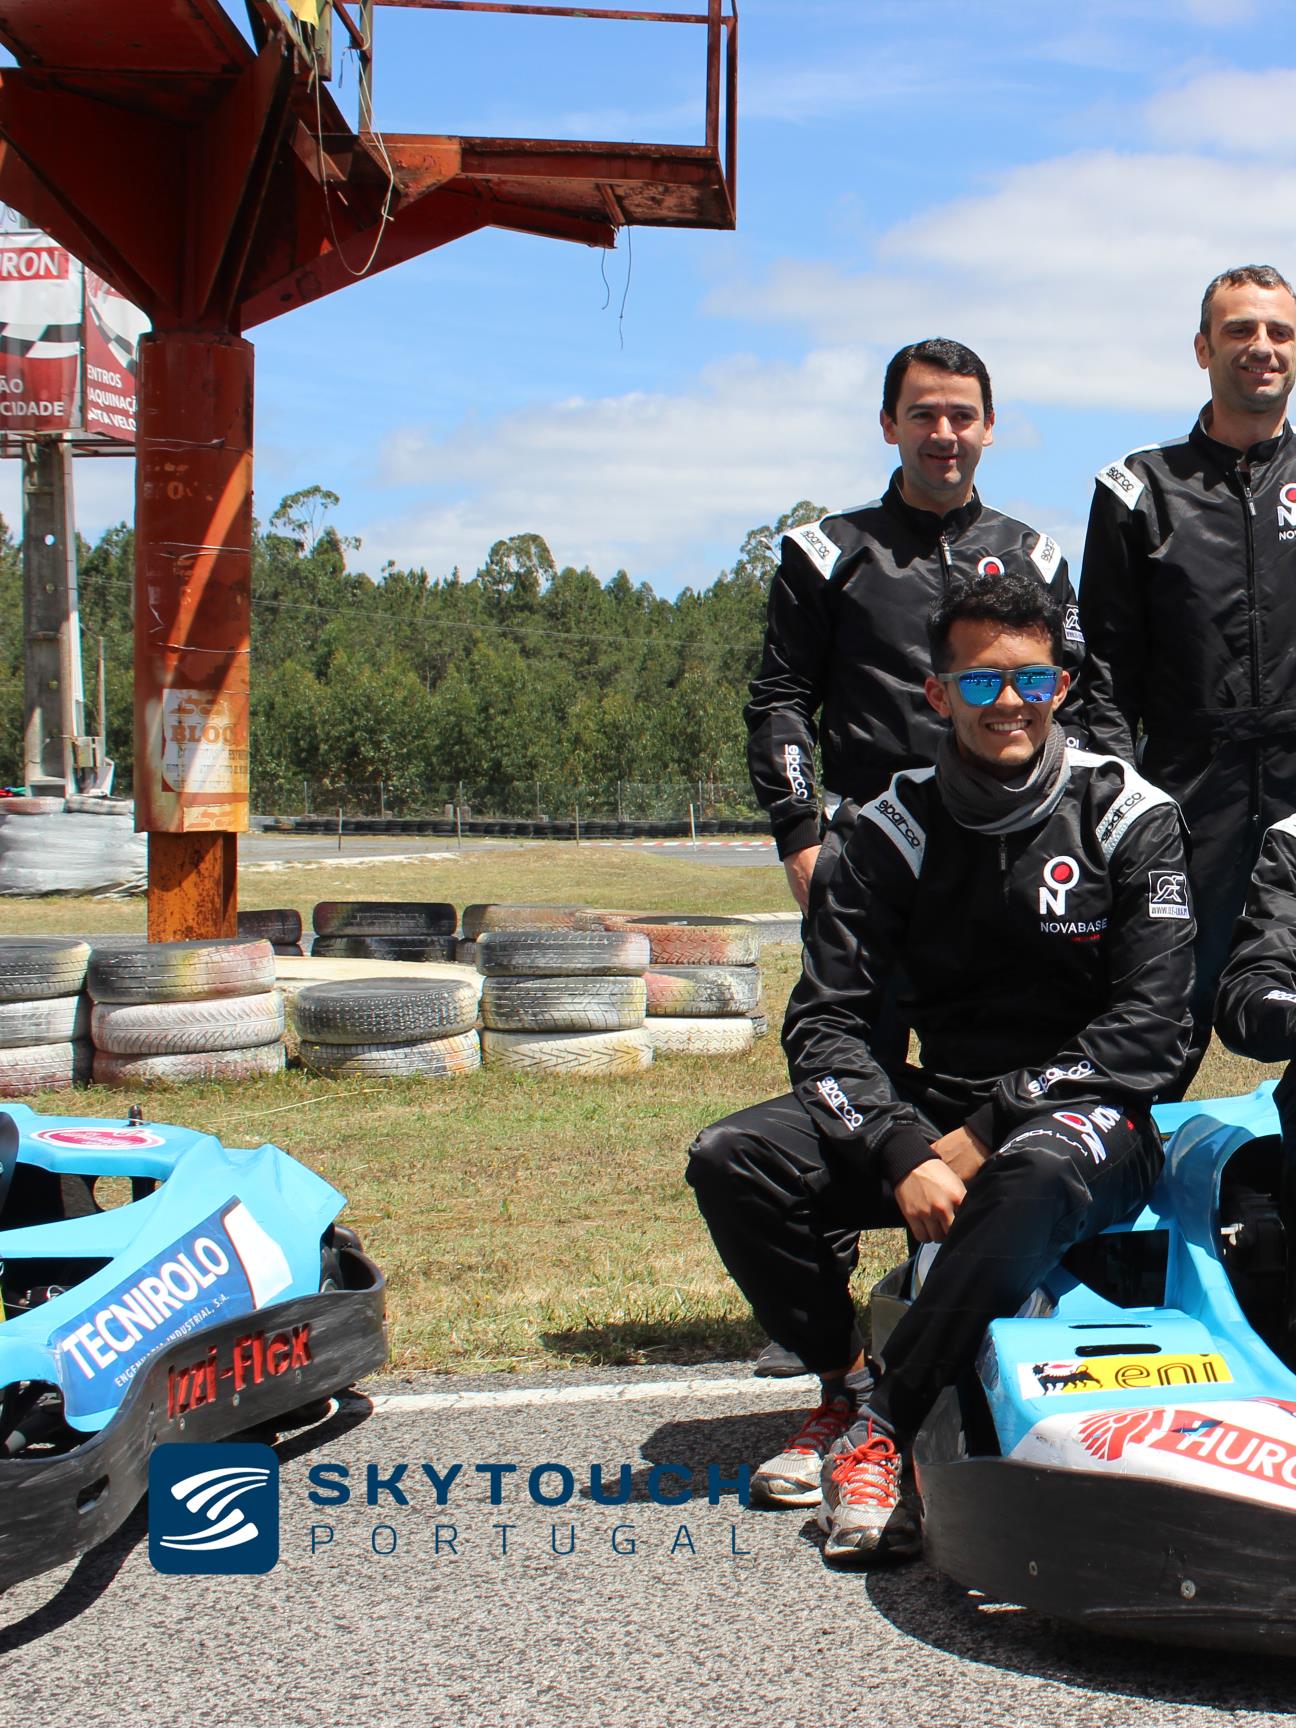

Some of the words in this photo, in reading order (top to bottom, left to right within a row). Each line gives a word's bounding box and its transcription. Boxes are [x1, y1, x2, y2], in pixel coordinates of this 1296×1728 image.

[875, 800, 920, 849] sparco
[1101, 793, 1146, 843] sparco
[1040, 918, 1107, 934] NOVABASE
[817, 1076, 864, 1131] sparco
[61, 1237, 229, 1379] TECNIROLO
[1115, 1352, 1218, 1388] eni
